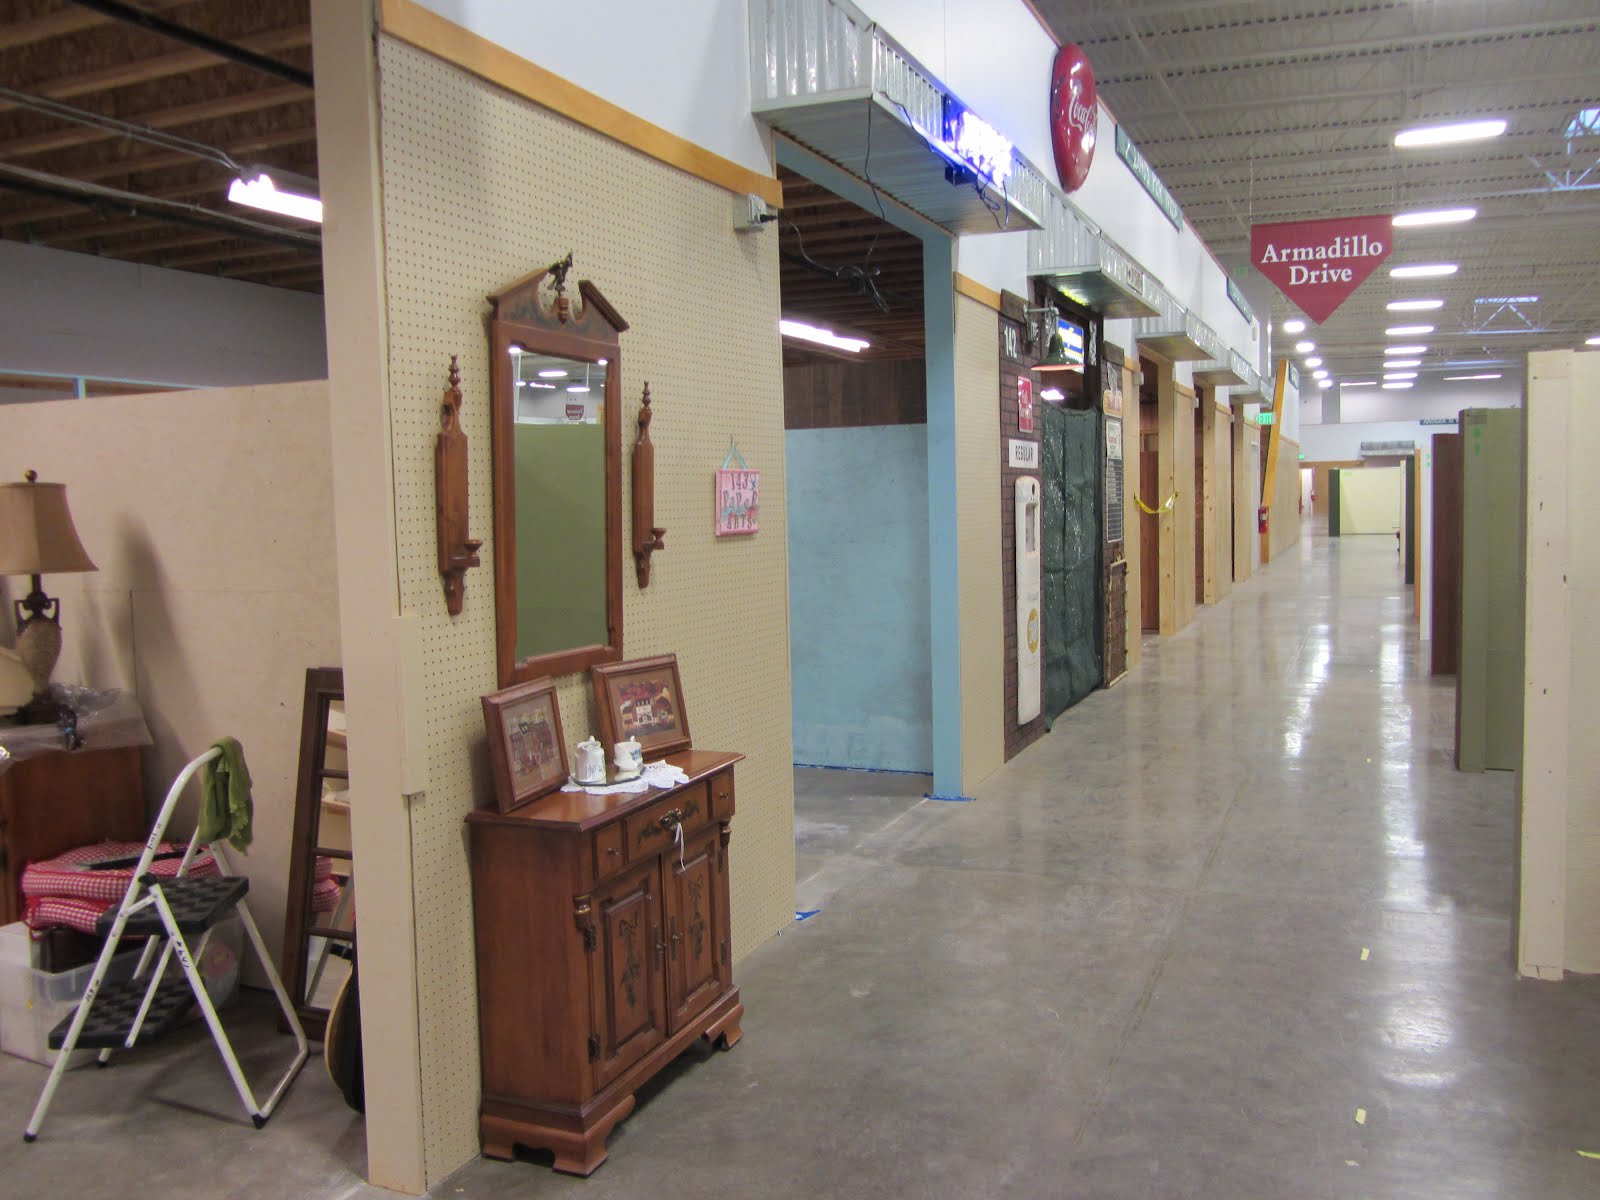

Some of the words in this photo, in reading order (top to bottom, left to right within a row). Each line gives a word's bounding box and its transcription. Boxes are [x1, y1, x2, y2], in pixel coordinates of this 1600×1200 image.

[1261, 235, 1383, 263] Armadillo
[1289, 263, 1353, 285] Drive
[1004, 325, 1017, 358] 142
[1259, 413, 1273, 425] EXIT
[1015, 445, 1033, 462] REGULAR
[731, 472, 748, 490] 143
[727, 514, 752, 530] ARTS
